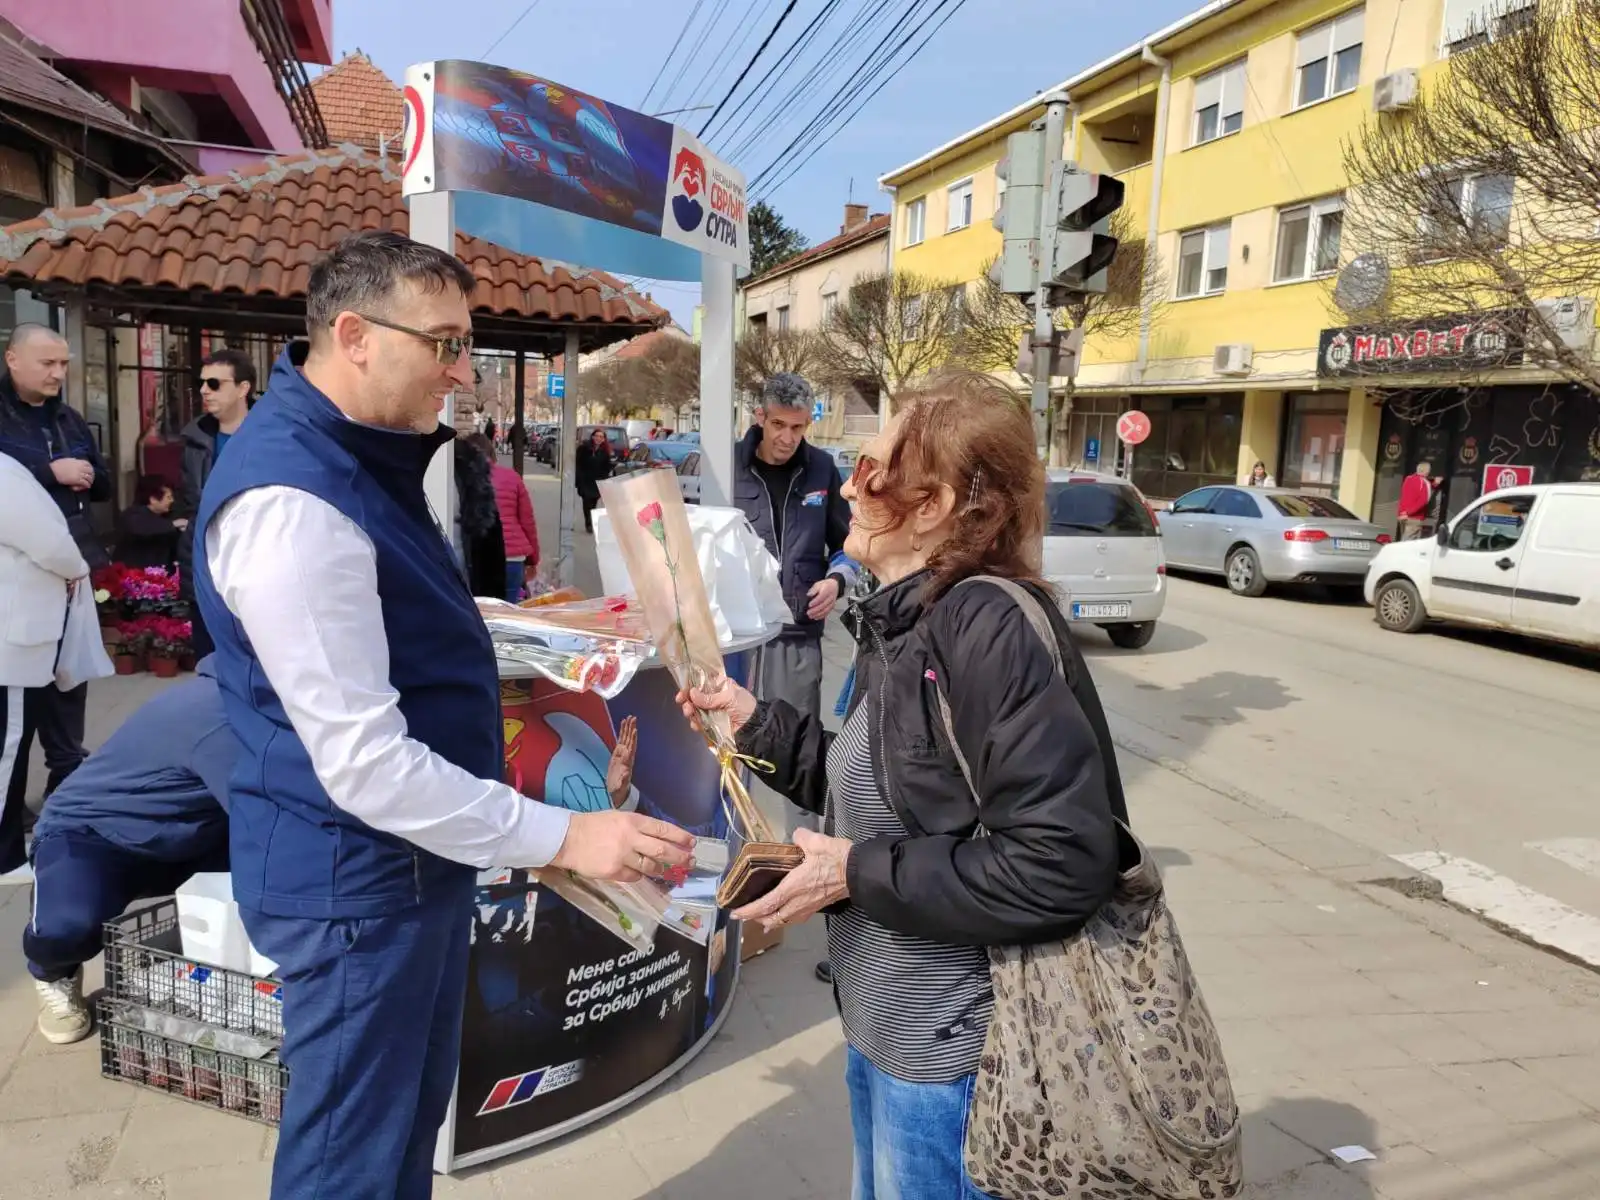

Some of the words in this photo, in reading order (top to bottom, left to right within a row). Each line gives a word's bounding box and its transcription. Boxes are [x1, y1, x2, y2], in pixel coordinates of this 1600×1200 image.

[711, 183, 744, 223] СВРЉИГ
[706, 211, 737, 248] СУТРА
[565, 974, 626, 1008] Србија
[627, 950, 681, 985] занима,
[566, 958, 615, 985] Мене
[562, 1011, 586, 1031] за
[589, 987, 644, 1022] Србију
[644, 959, 691, 999] живим!
